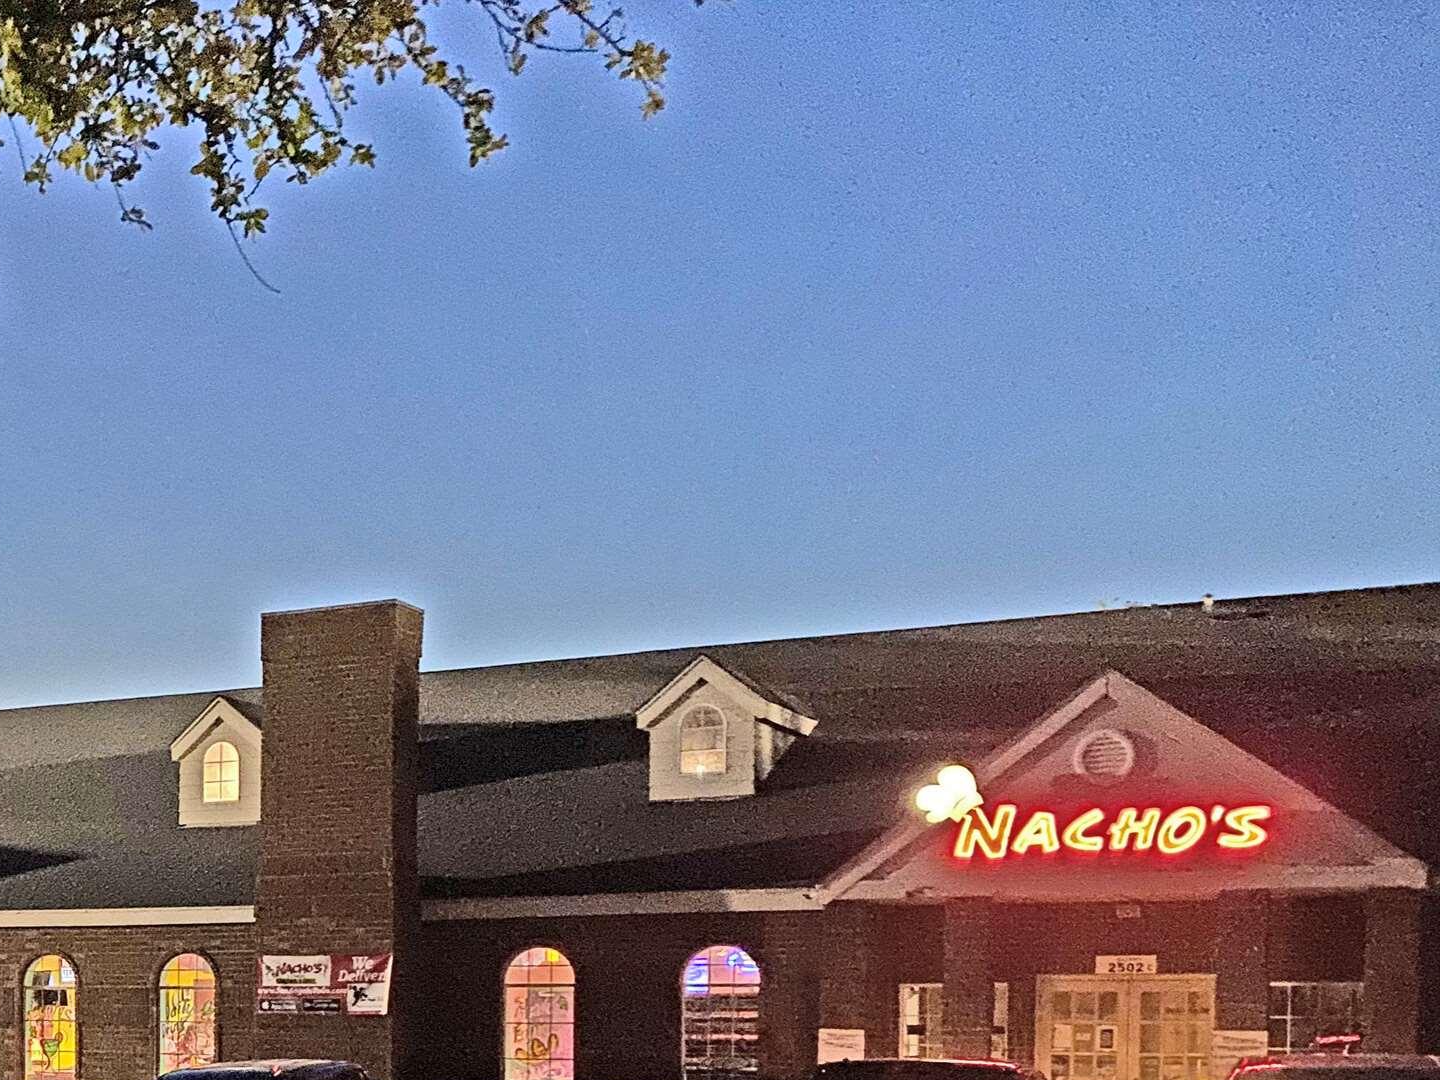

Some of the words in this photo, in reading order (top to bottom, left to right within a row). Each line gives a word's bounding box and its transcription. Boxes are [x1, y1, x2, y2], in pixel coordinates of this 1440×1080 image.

[954, 804, 1272, 859] NACHO'S
[351, 956, 374, 970] We
[1108, 962, 1144, 973] 2502
